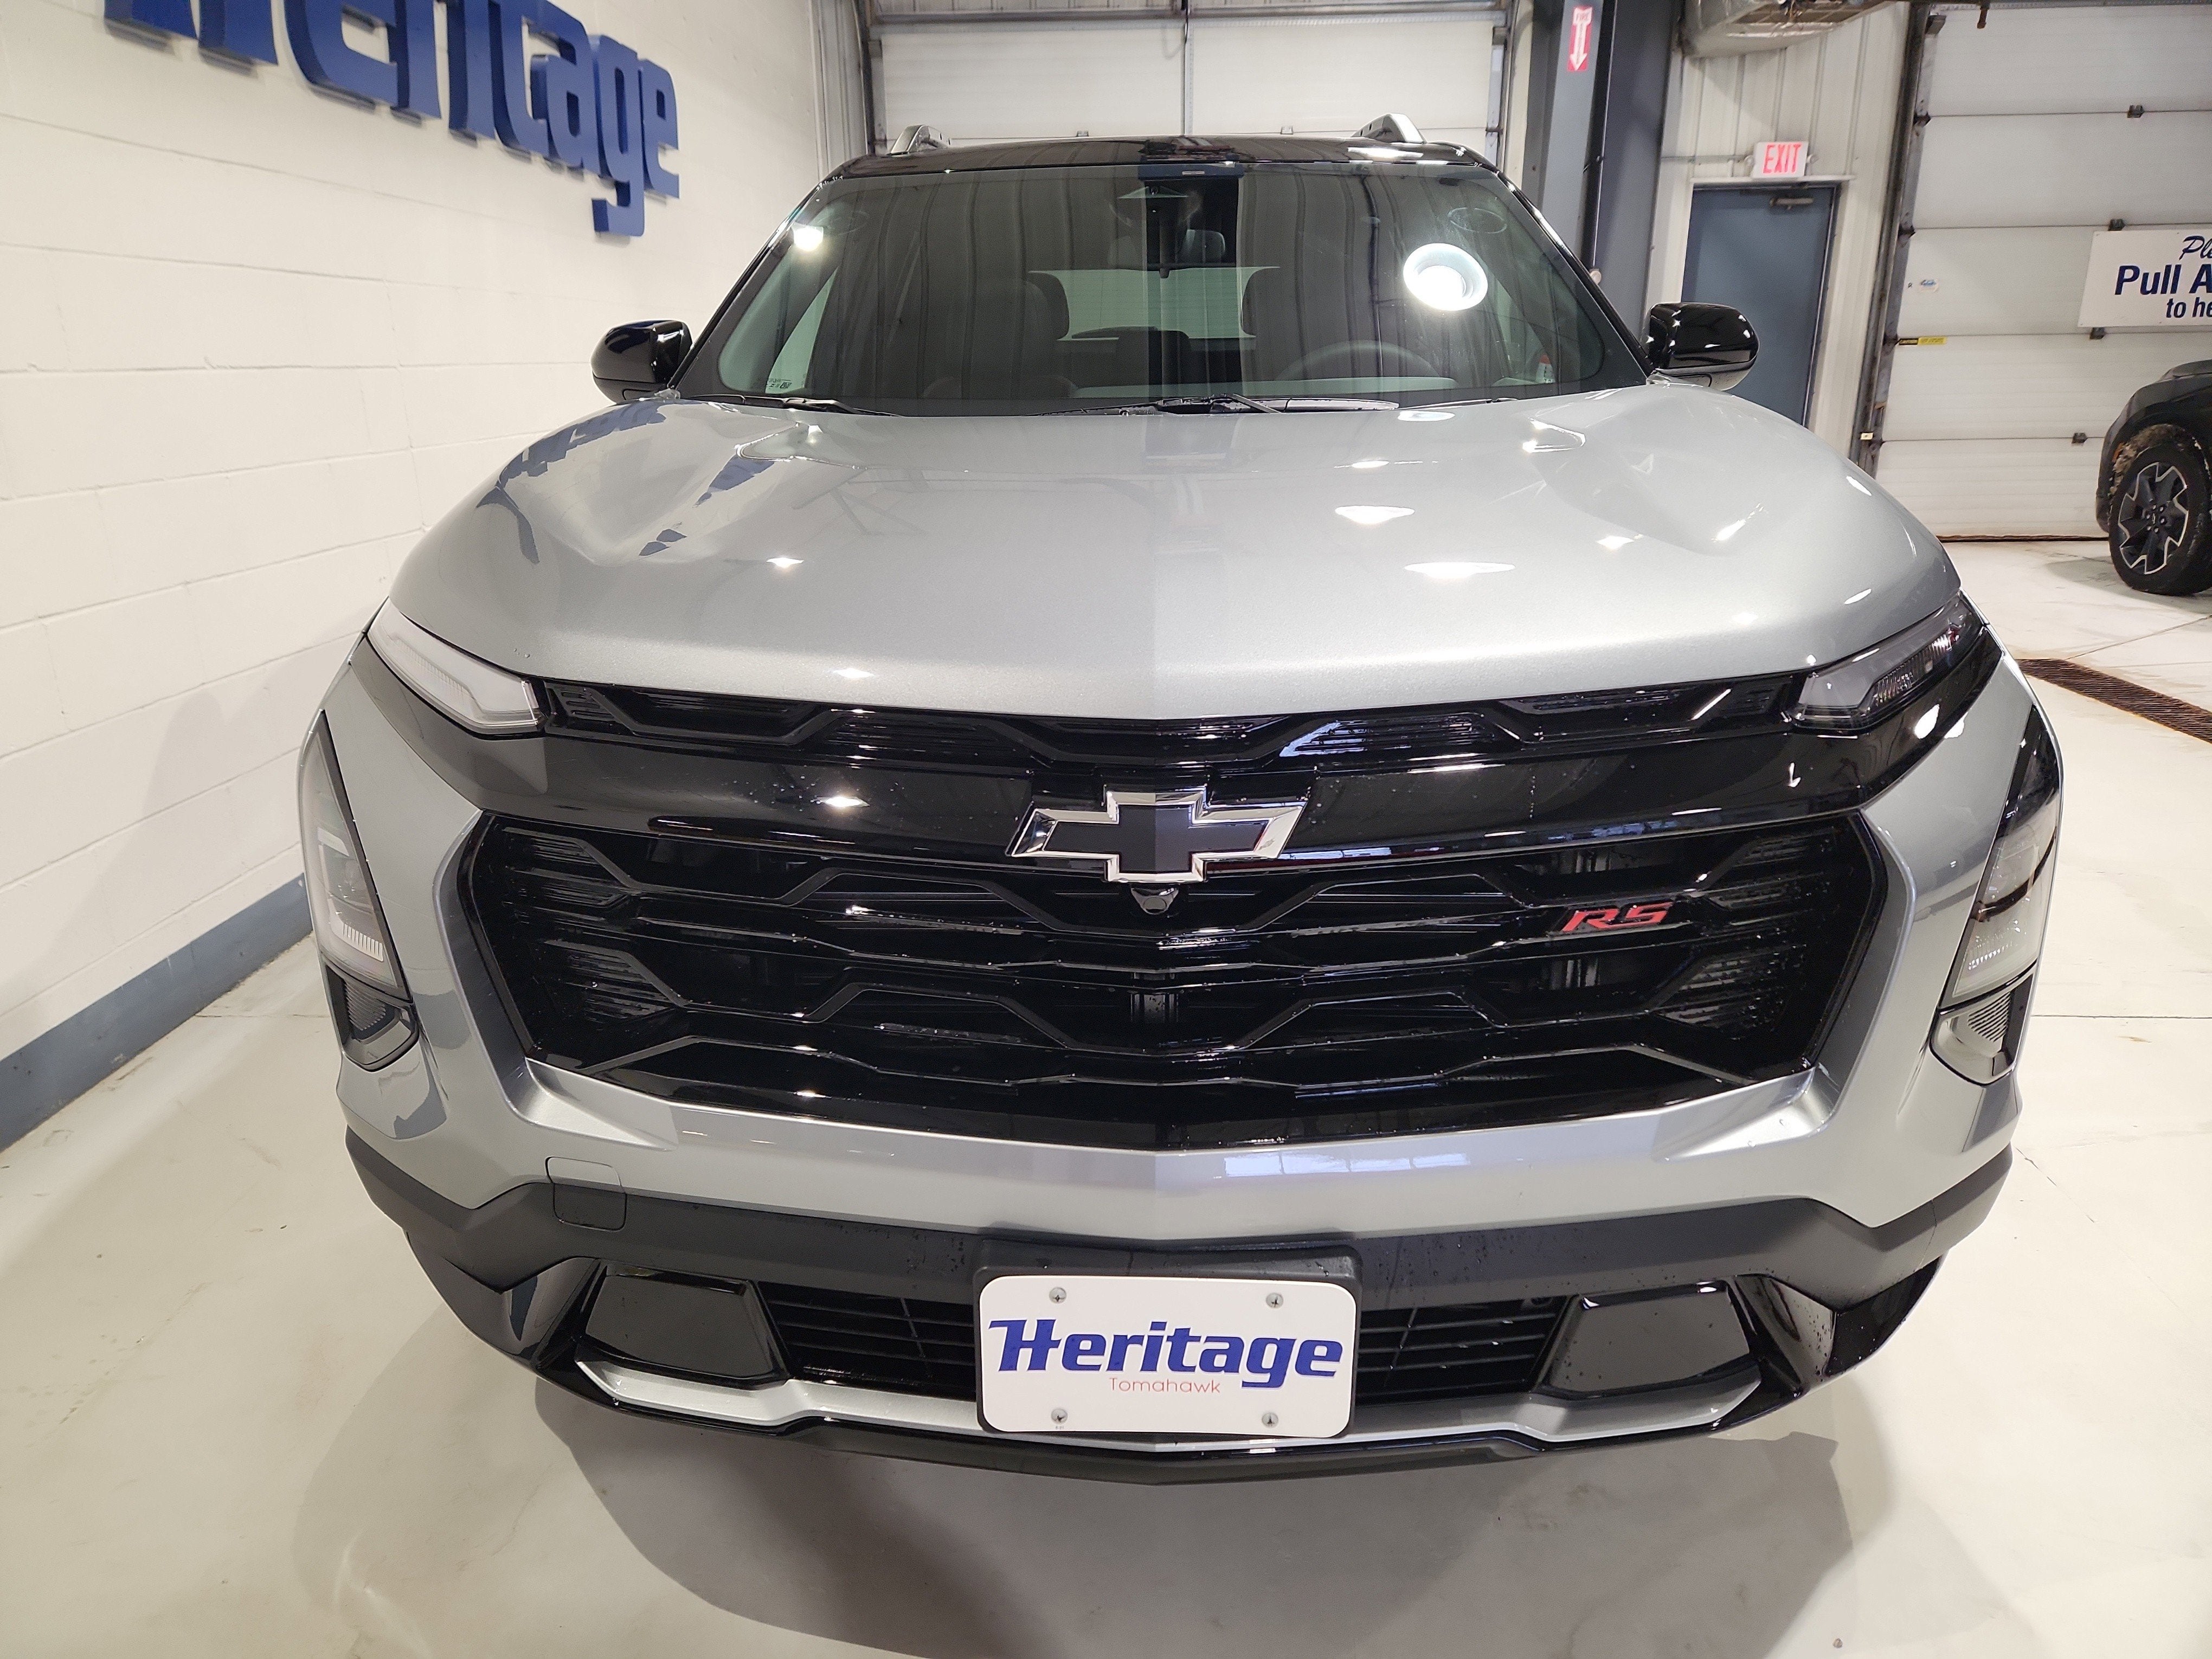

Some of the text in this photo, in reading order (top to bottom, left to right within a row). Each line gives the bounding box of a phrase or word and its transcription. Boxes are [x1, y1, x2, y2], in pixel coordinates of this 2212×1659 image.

[104, 0, 679, 237] itage
[1763, 143, 1802, 173] EXIT
[2114, 264, 2182, 295] Pull
[2166, 298, 2186, 318] to
[1561, 902, 1673, 933] RS
[988, 1319, 1343, 1388] Heritage
[1109, 1378, 1220, 1393] Tomahawk
